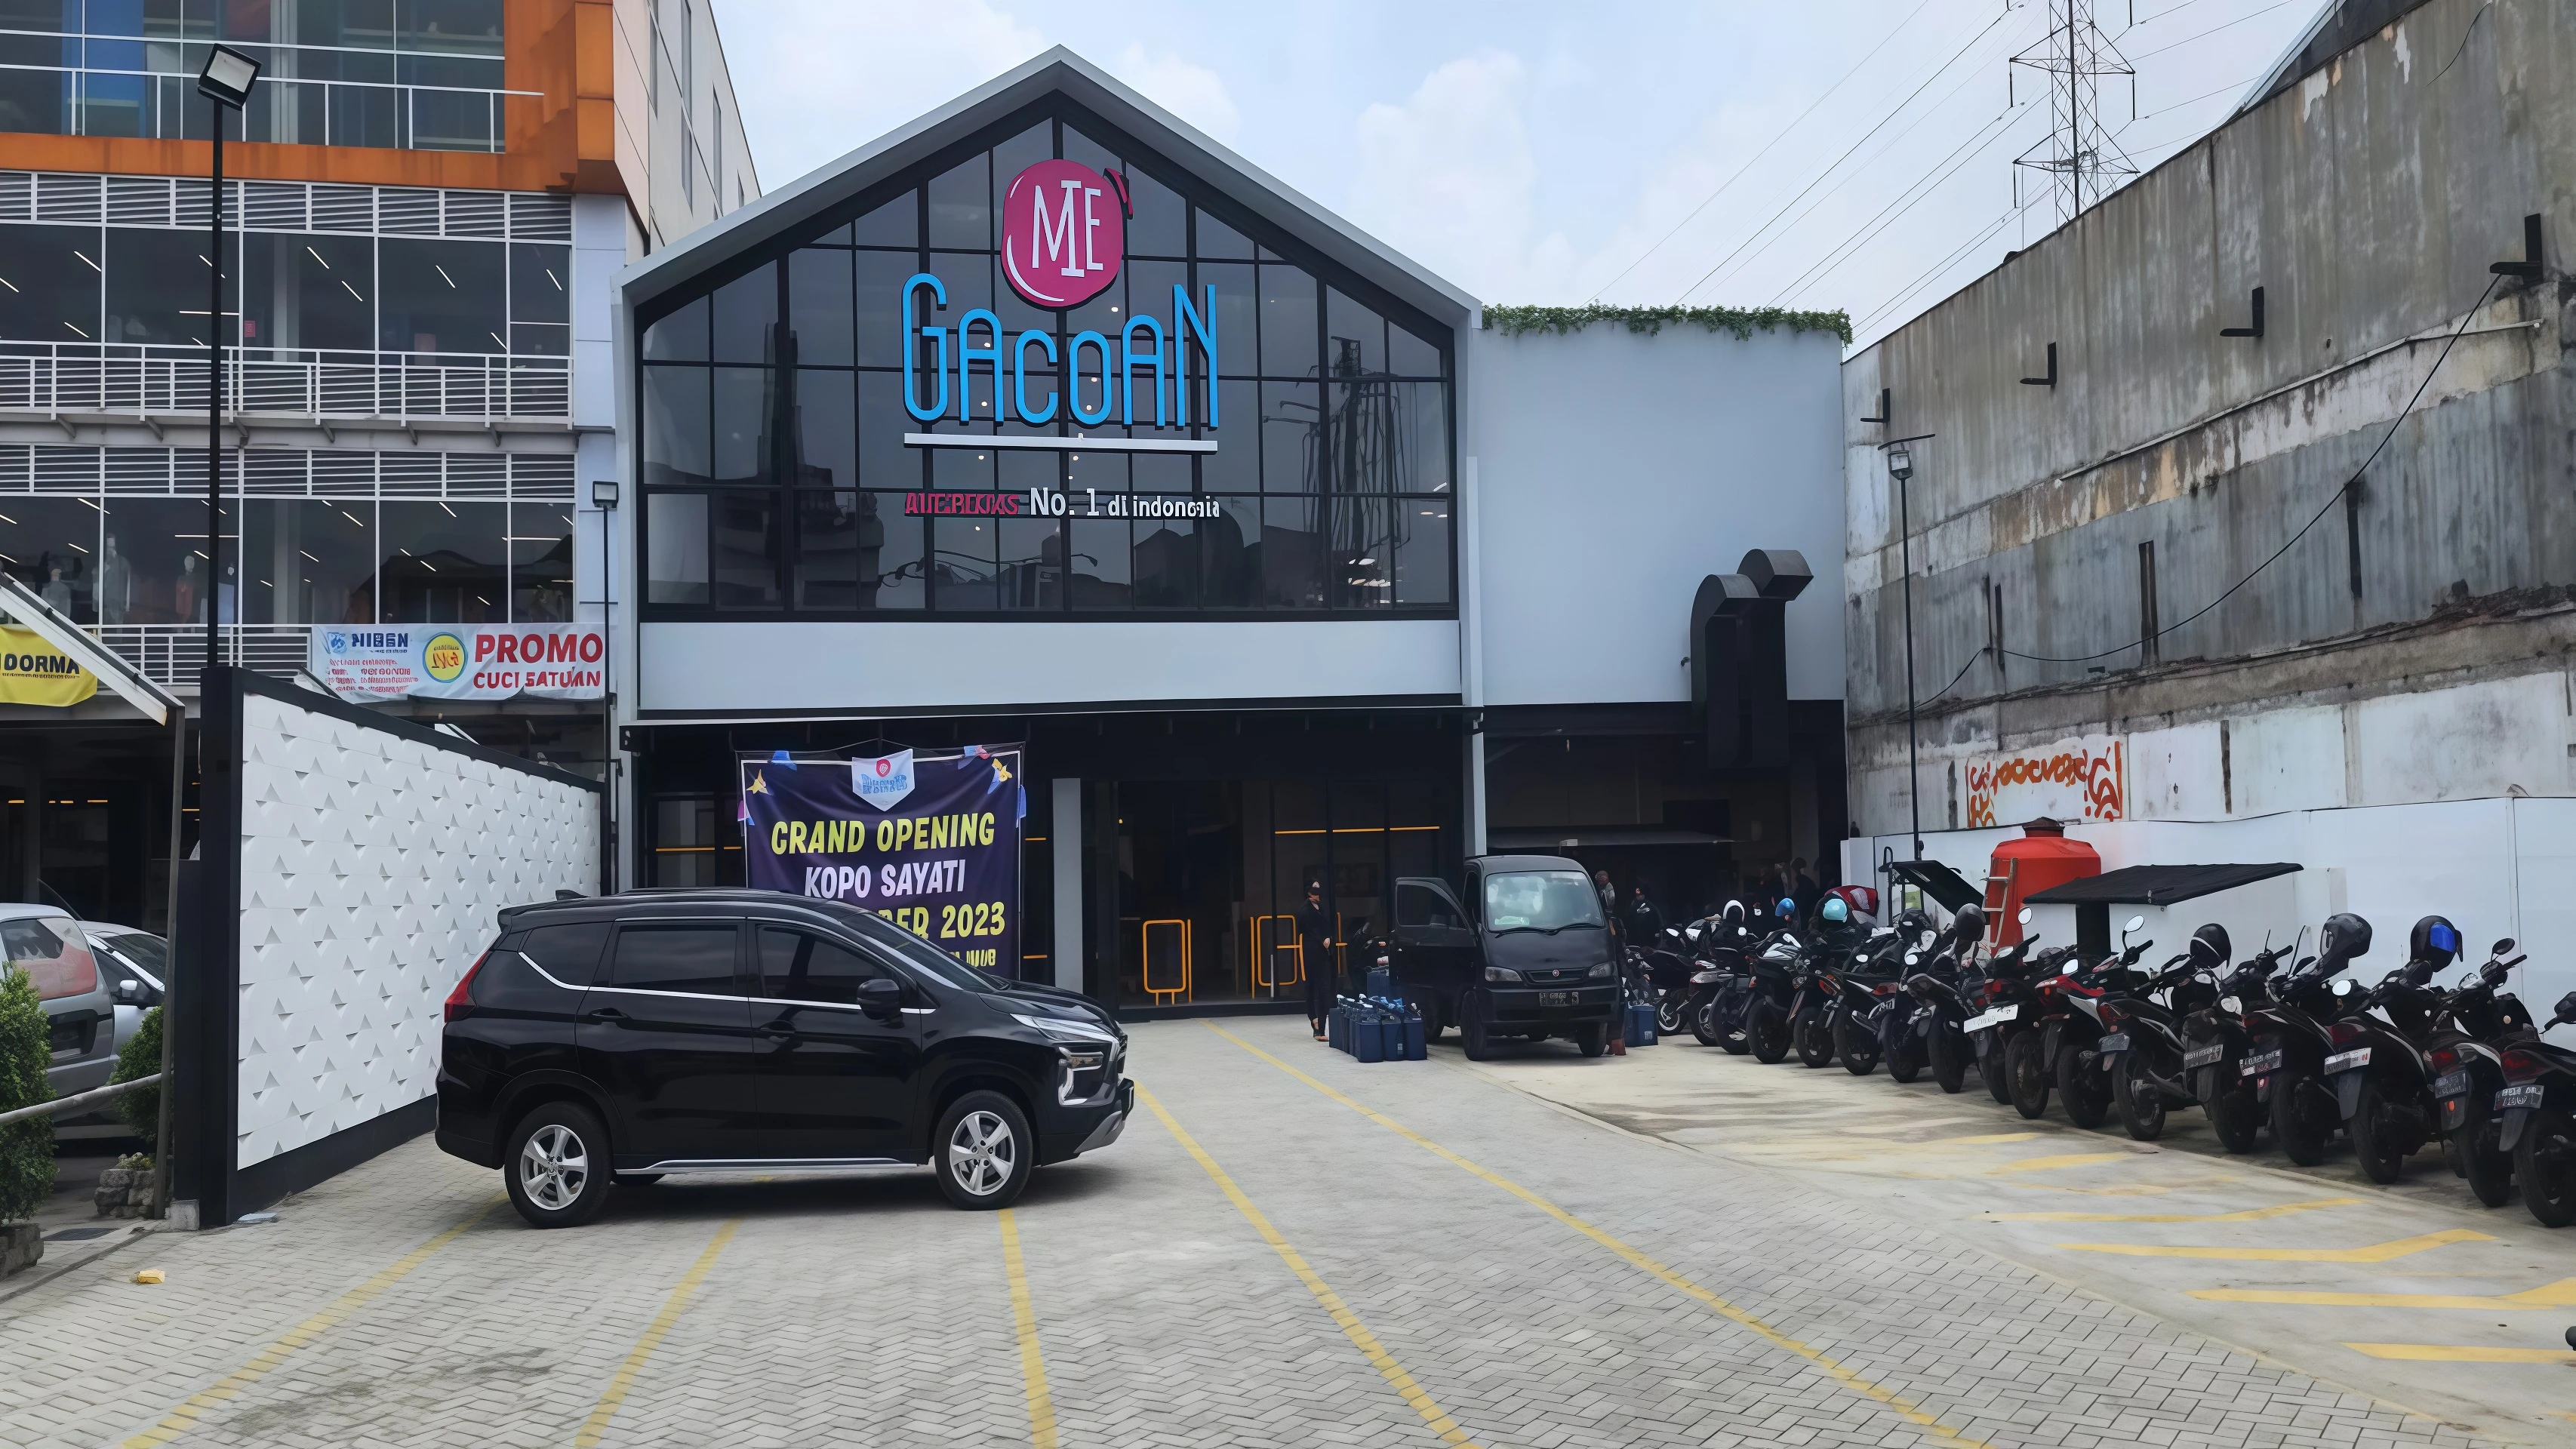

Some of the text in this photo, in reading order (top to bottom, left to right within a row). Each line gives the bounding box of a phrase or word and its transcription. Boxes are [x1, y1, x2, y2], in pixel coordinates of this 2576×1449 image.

[903, 273, 1219, 429] GACOAN
[1030, 488, 1075, 515] No.
[1087, 488, 1099, 515] 1
[1108, 495, 1128, 516] di
[0, 653, 79, 674] DORMA
[475, 633, 603, 663] PROMO
[473, 672, 520, 688] CUCI
[771, 812, 995, 855] GRAND OPENING
[805, 859, 966, 899] KOPO SAYATI
[940, 901, 1005, 938] 2023
